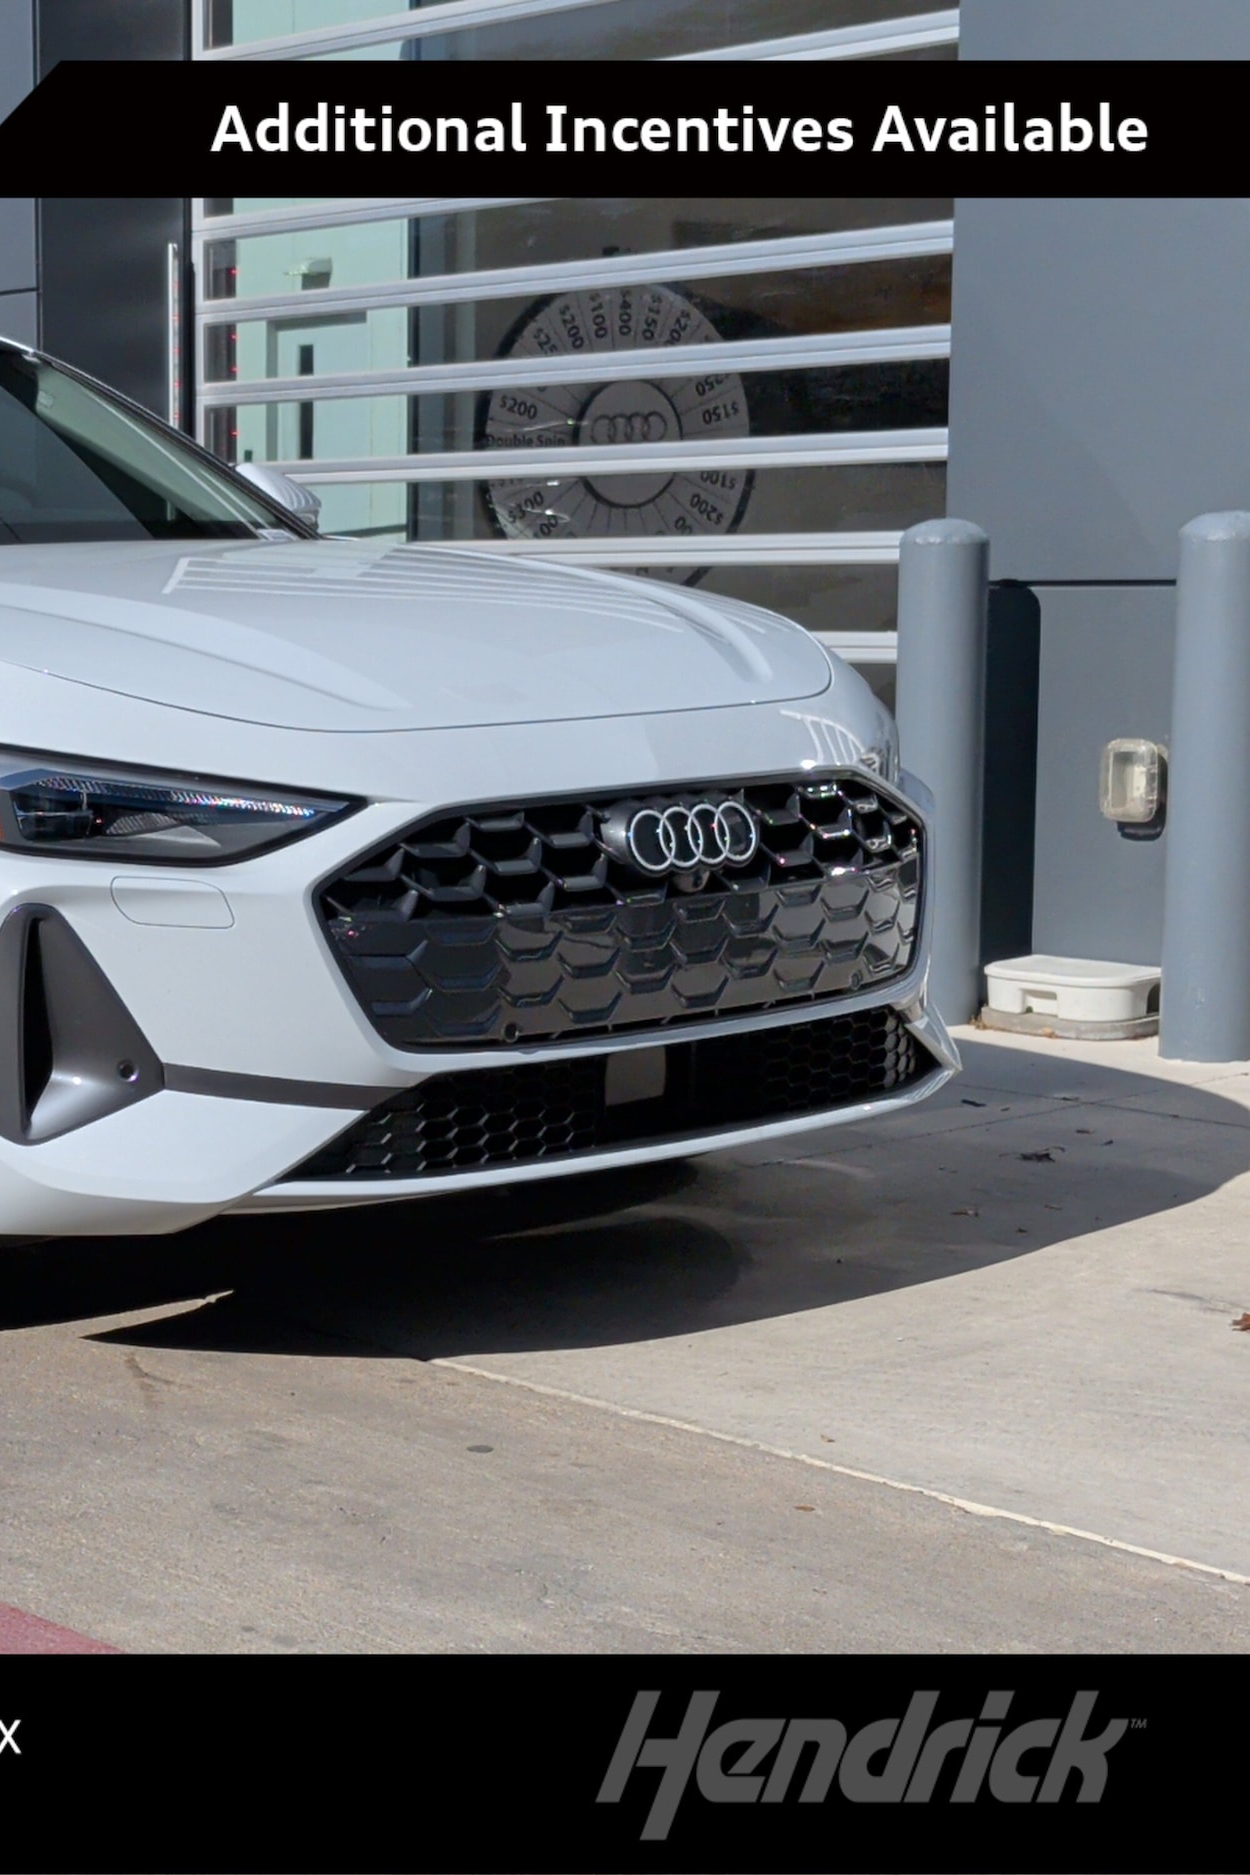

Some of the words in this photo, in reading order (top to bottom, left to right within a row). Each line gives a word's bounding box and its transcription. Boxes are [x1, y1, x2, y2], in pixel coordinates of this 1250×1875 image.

[558, 304, 585, 350] $200
[499, 394, 538, 420] $200
[701, 401, 740, 426] $150
[486, 433, 534, 448] Double
[689, 493, 724, 526] $200
